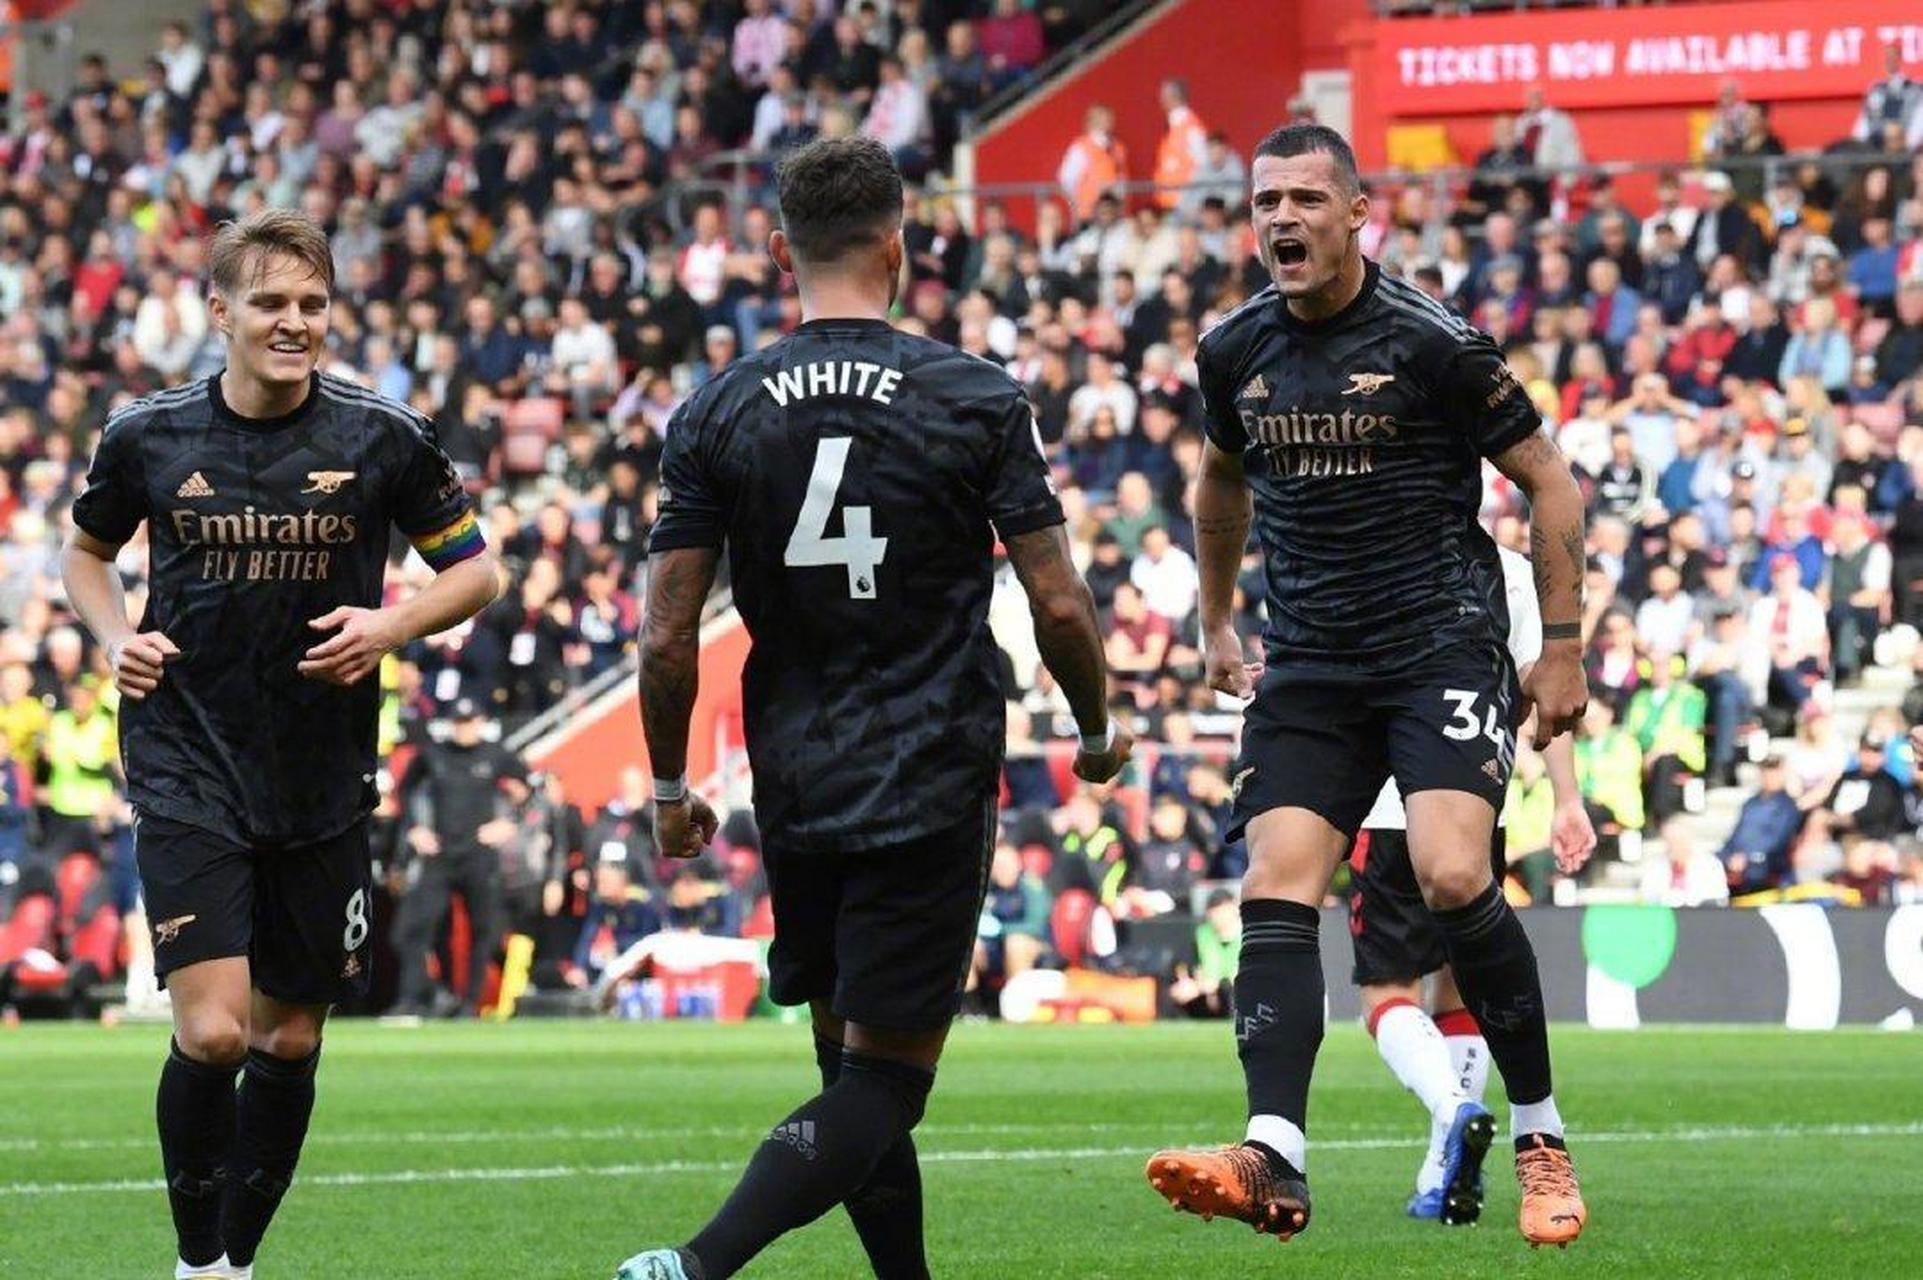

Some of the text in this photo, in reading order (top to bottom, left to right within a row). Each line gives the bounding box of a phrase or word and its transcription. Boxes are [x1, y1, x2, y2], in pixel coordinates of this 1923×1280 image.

[1397, 42, 1538, 86] TICKETS
[1548, 40, 1615, 79] NOW
[1624, 30, 1810, 76] AVAILABLE
[1822, 26, 1865, 65] AT
[762, 360, 904, 407] WHITE
[1240, 404, 1397, 449] Emirates
[171, 505, 356, 545] Emirates
[784, 436, 888, 599] 4
[202, 550, 330, 581] FLY BETTER
[1442, 688, 1506, 760] 34
[344, 887, 369, 952] 8
